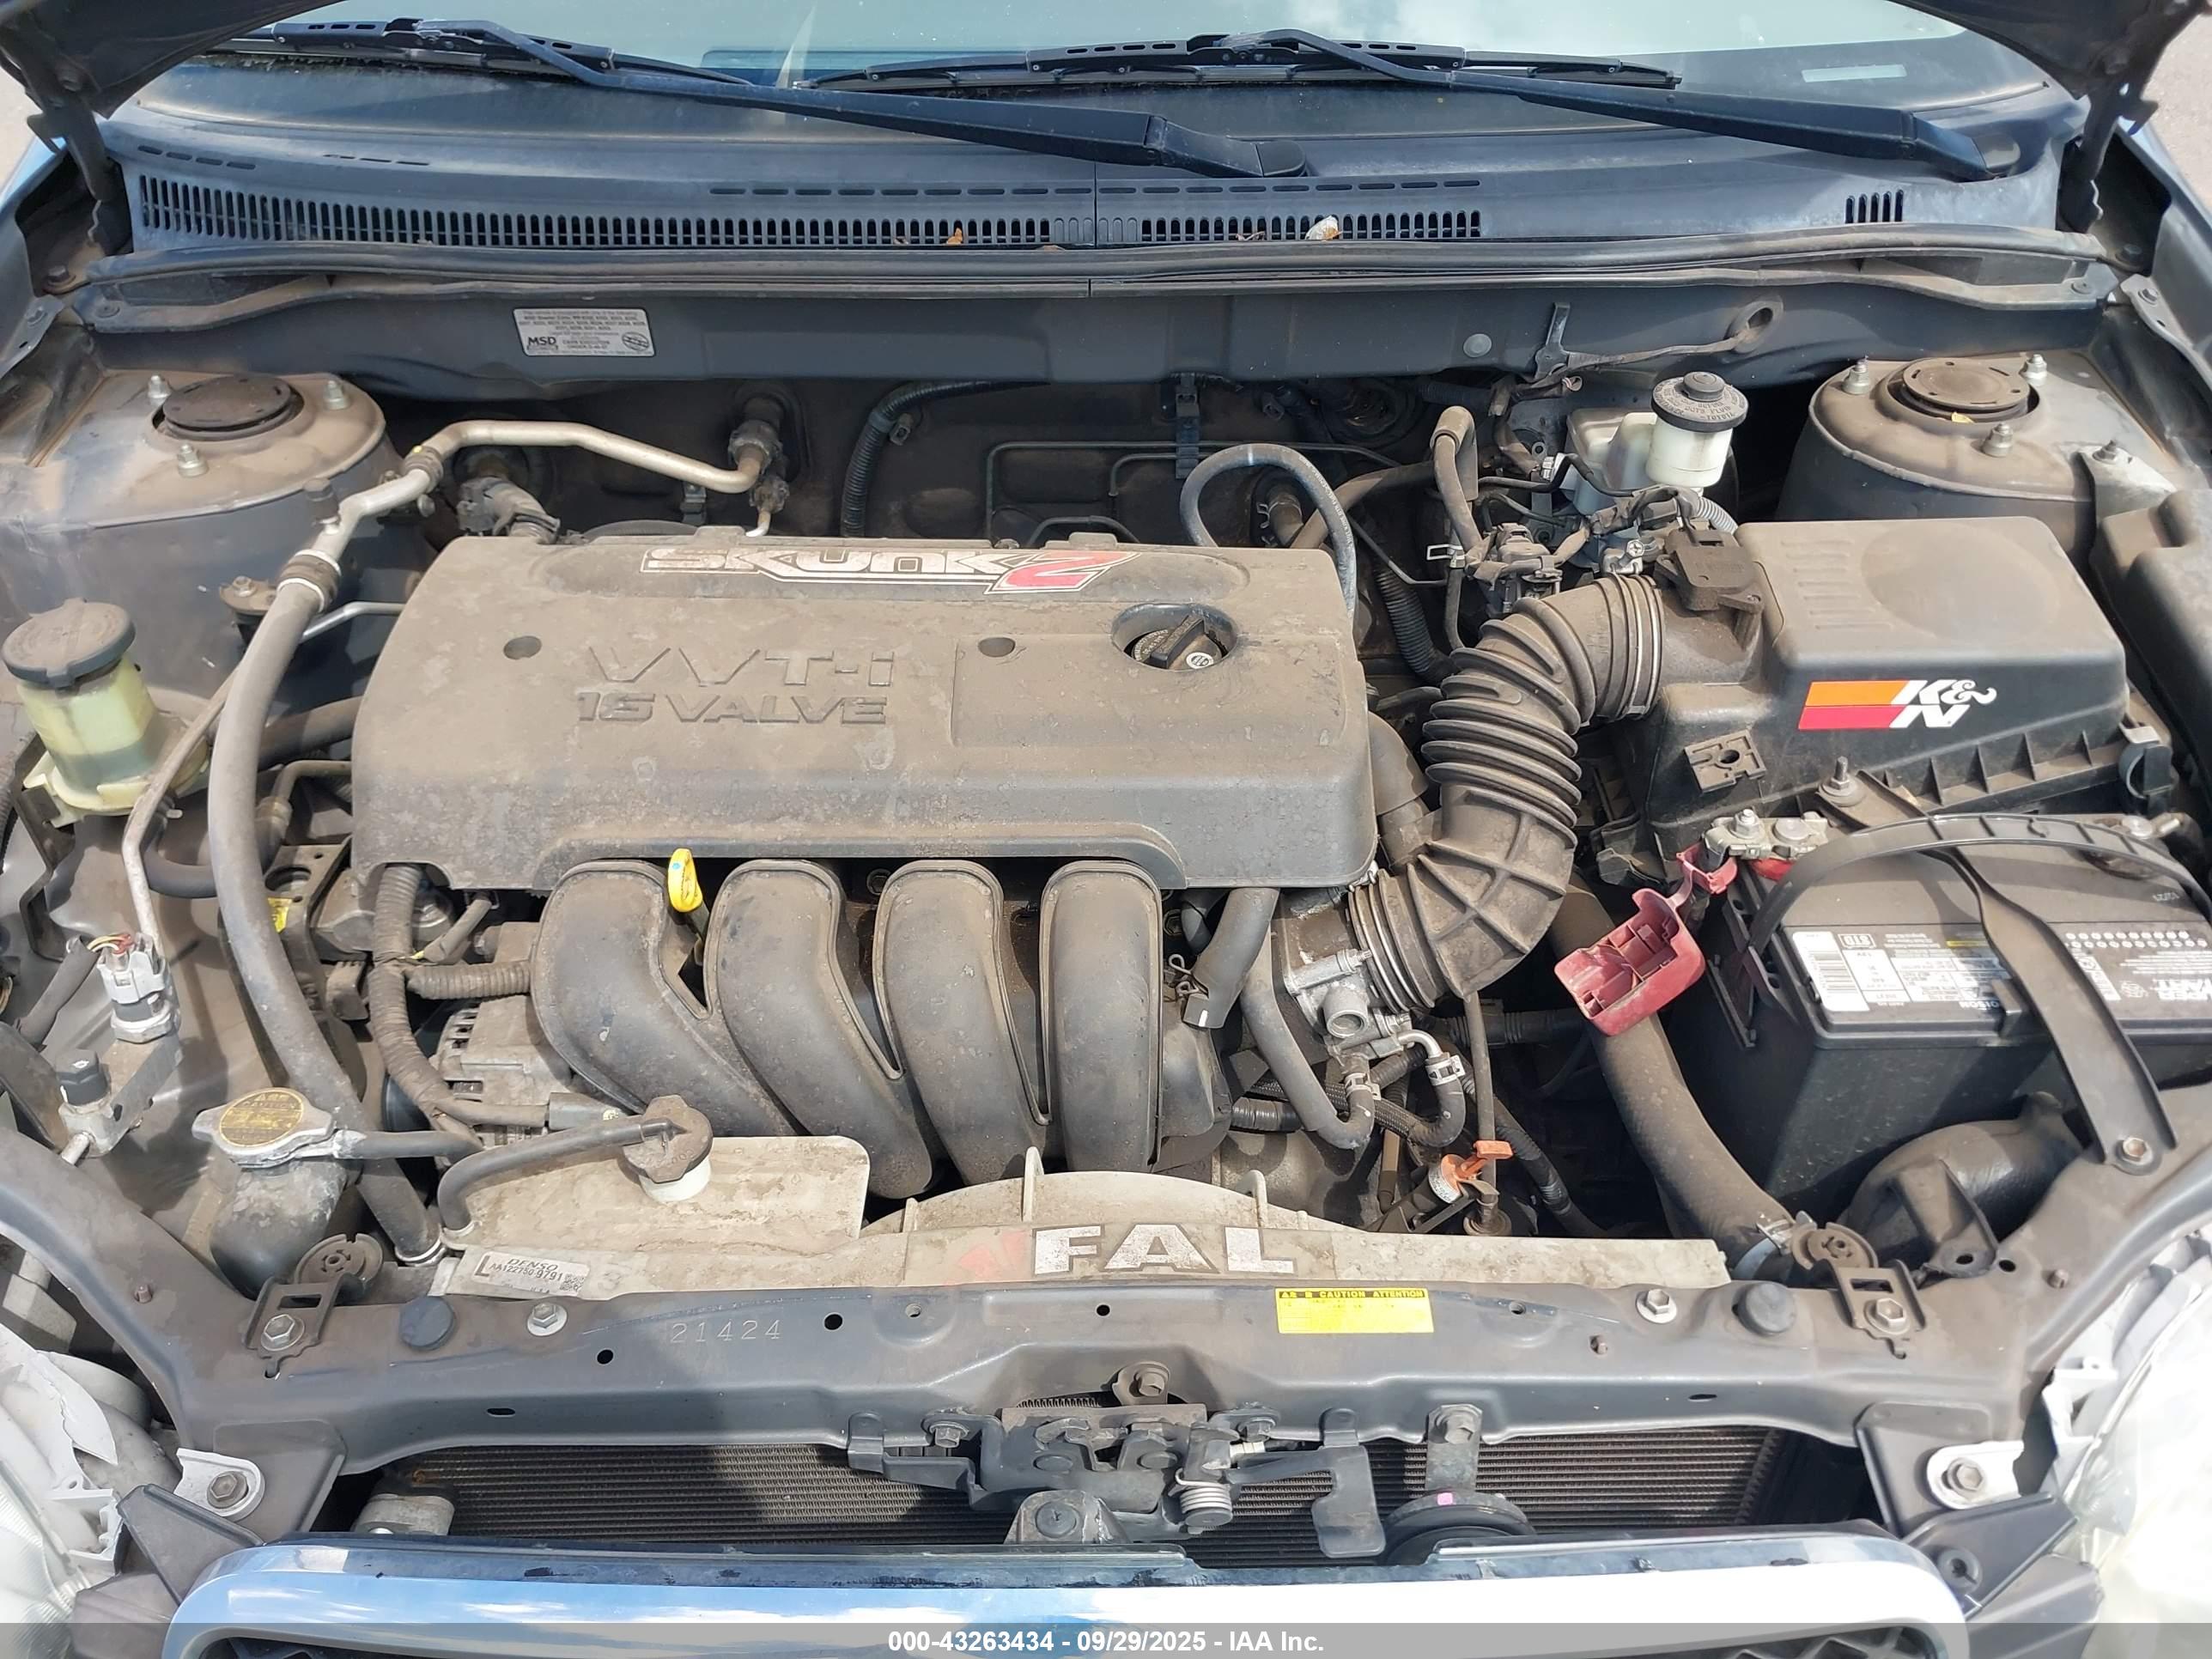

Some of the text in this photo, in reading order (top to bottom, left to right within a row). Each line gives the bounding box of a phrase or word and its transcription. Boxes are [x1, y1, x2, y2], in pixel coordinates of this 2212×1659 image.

[527, 336, 557, 346] MSD
[665, 693, 888, 726] VALVE
[1959, 1000, 2000, 1009] OISON
[1031, 1224, 1295, 1275] FAL
[507, 1258, 558, 1271] DENSO
[1318, 1290, 1424, 1299] CAUTION ATTENTION
[670, 1318, 784, 1344] 21424
